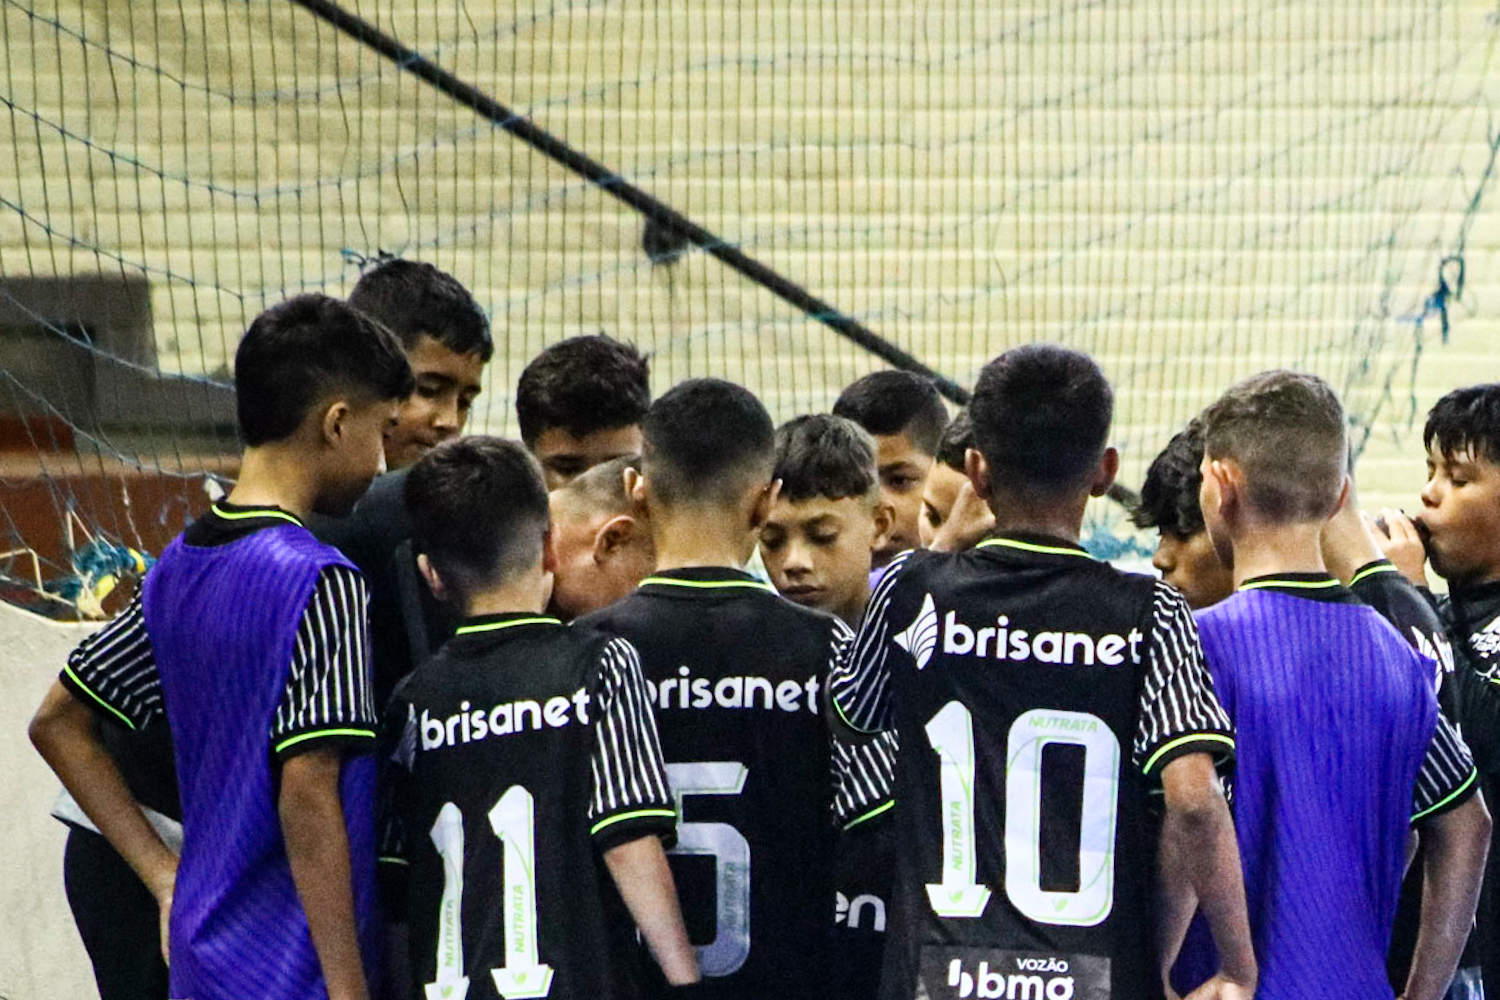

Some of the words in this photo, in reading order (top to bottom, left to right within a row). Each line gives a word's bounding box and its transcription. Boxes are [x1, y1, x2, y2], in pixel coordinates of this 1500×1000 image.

[943, 609, 1143, 666] brisanet
[420, 687, 590, 750] brisanet
[1029, 715, 1098, 732] NUTRATA
[924, 700, 1121, 927] 10
[951, 801, 963, 870] NUTRATA
[664, 761, 751, 977] 5
[514, 885, 525, 953] NUTRATA
[1017, 957, 1069, 973] VOZÃO
